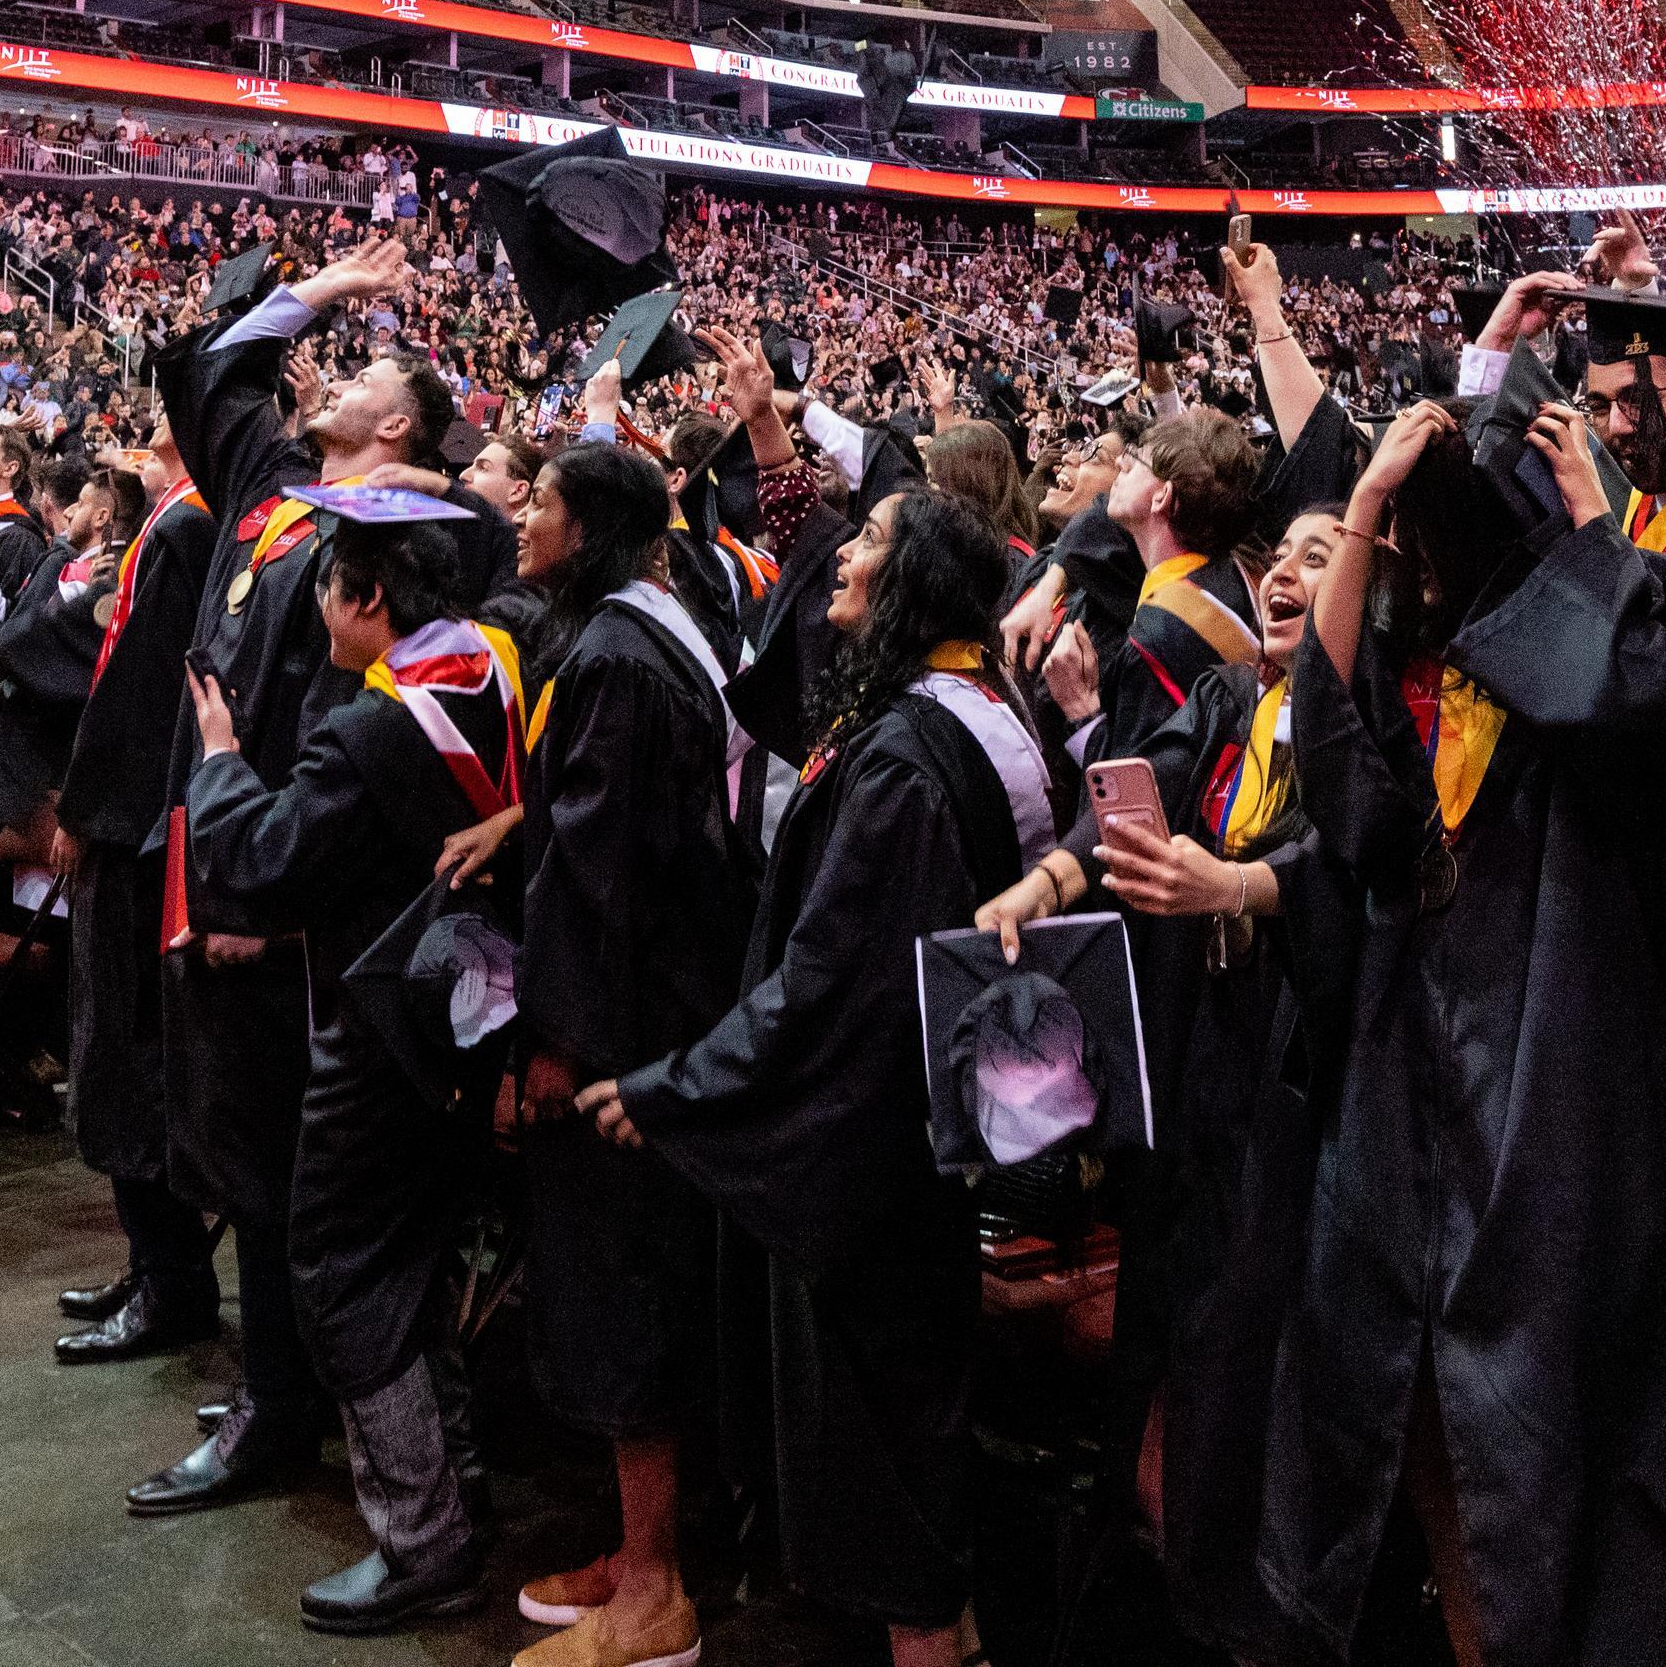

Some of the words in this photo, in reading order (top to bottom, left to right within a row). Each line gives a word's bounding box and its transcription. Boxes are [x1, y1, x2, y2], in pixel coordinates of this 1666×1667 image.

[551, 22, 583, 38] NJIT
[1086, 41, 1124, 51] EST.
[1, 45, 50, 64] NJIT
[1074, 55, 1132, 69] 1982
[236, 77, 279, 94] NJIT
[942, 88, 1046, 110] GRADUATES
[1318, 89, 1350, 102] NJIT
[1128, 103, 1188, 118] Citizens
[750, 149, 853, 180] GRADUATES
[973, 177, 1003, 190] NJIT
[1119, 186, 1149, 199] NJIT
[1273, 191, 1305, 203] NJIT
